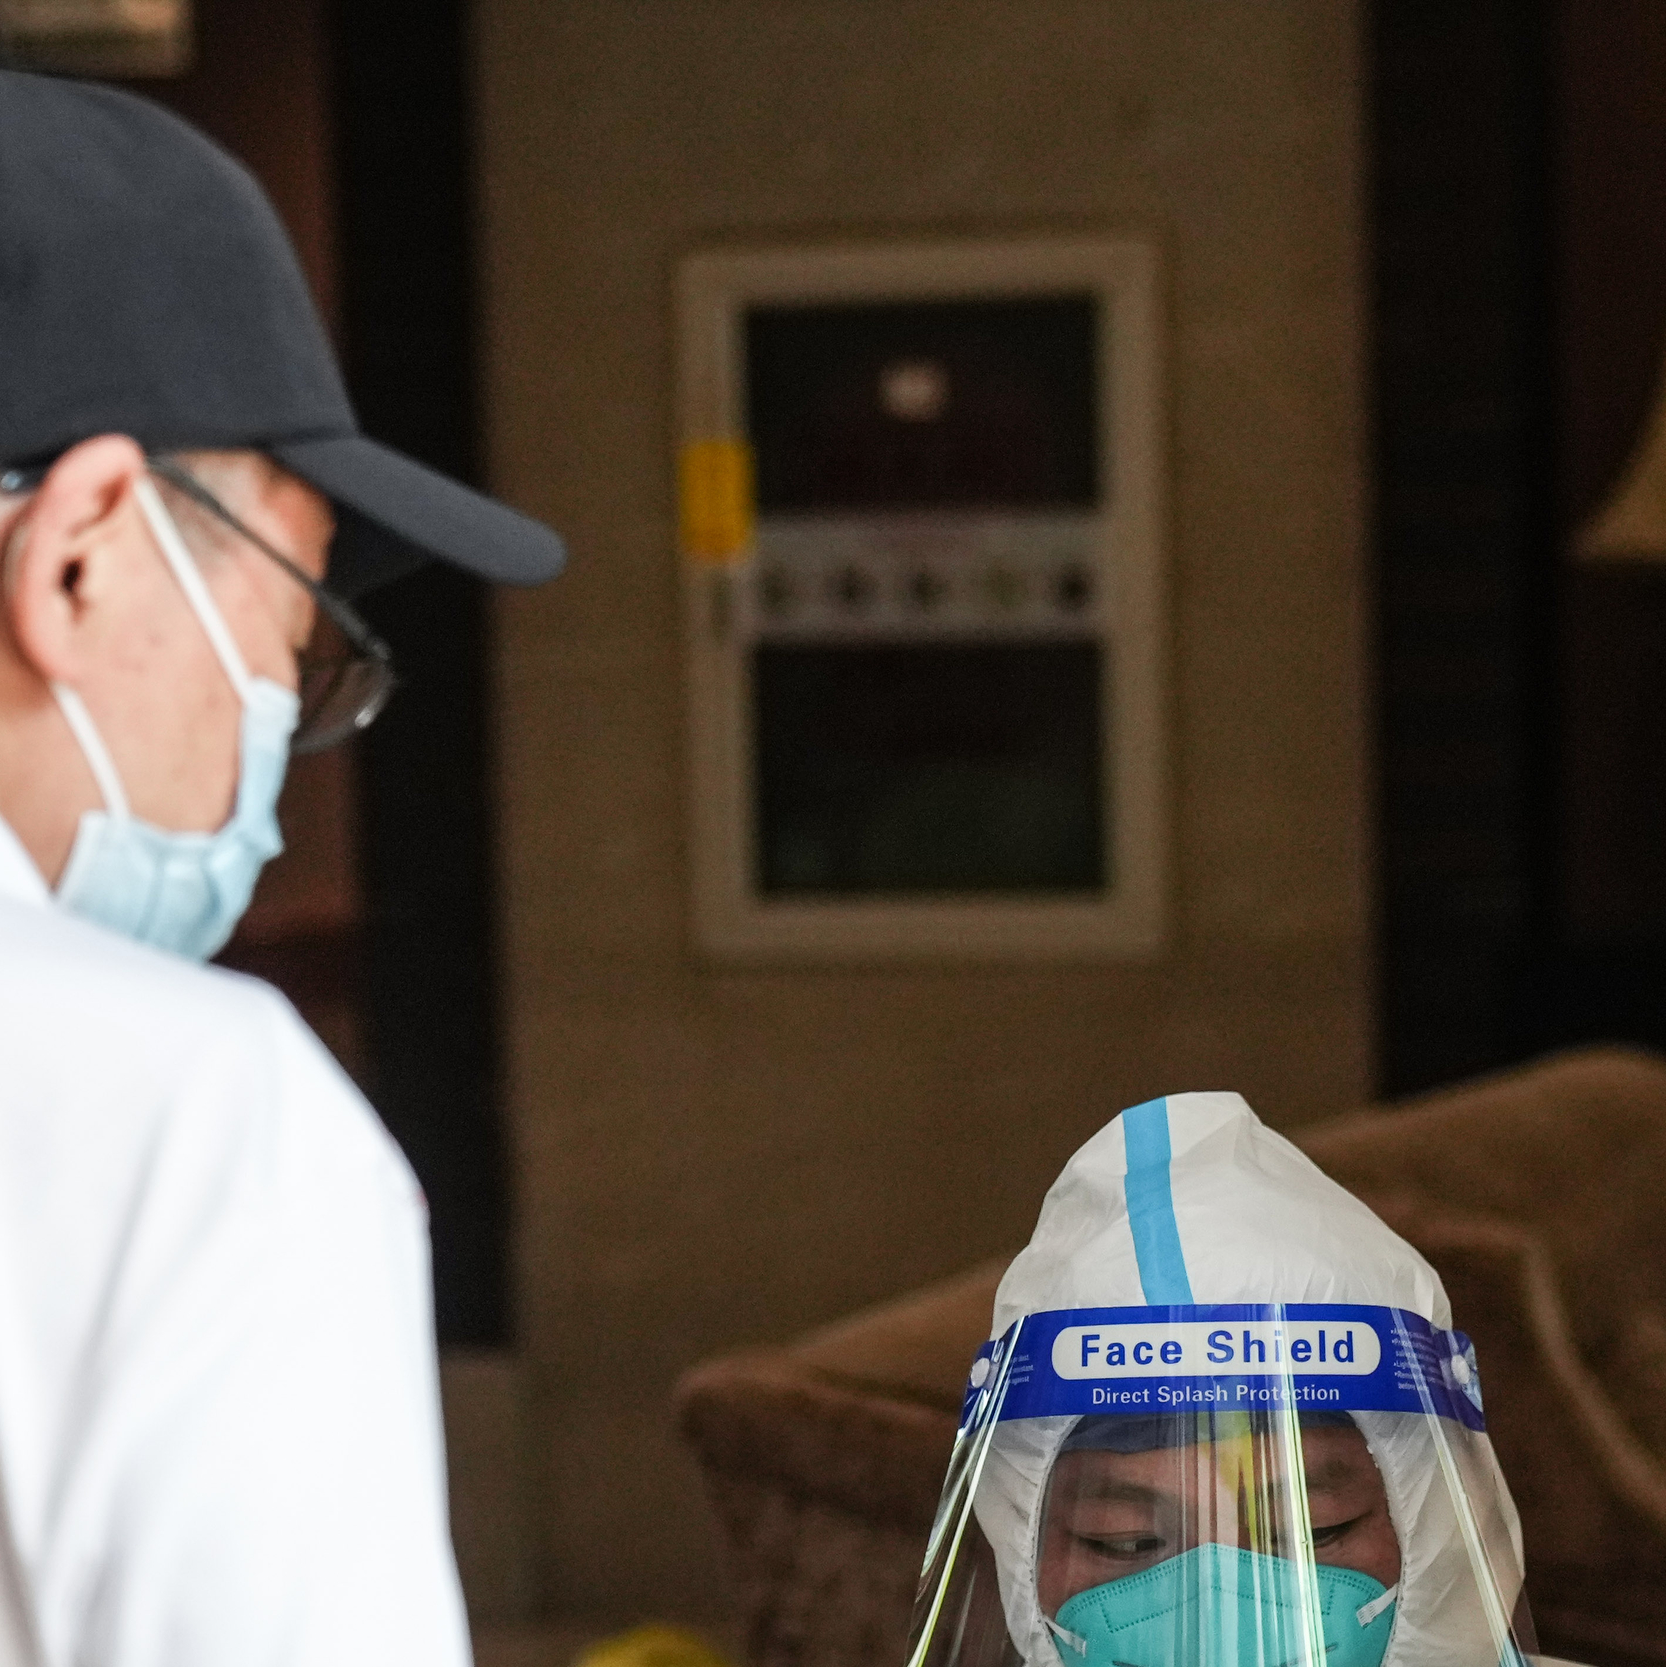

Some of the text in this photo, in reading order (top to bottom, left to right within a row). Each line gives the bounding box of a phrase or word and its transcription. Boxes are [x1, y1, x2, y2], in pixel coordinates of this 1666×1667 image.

[1080, 1333, 1184, 1368] Face
[1206, 1329, 1356, 1364] Shield
[1091, 1382, 1341, 1405] Direct Splash Protection
